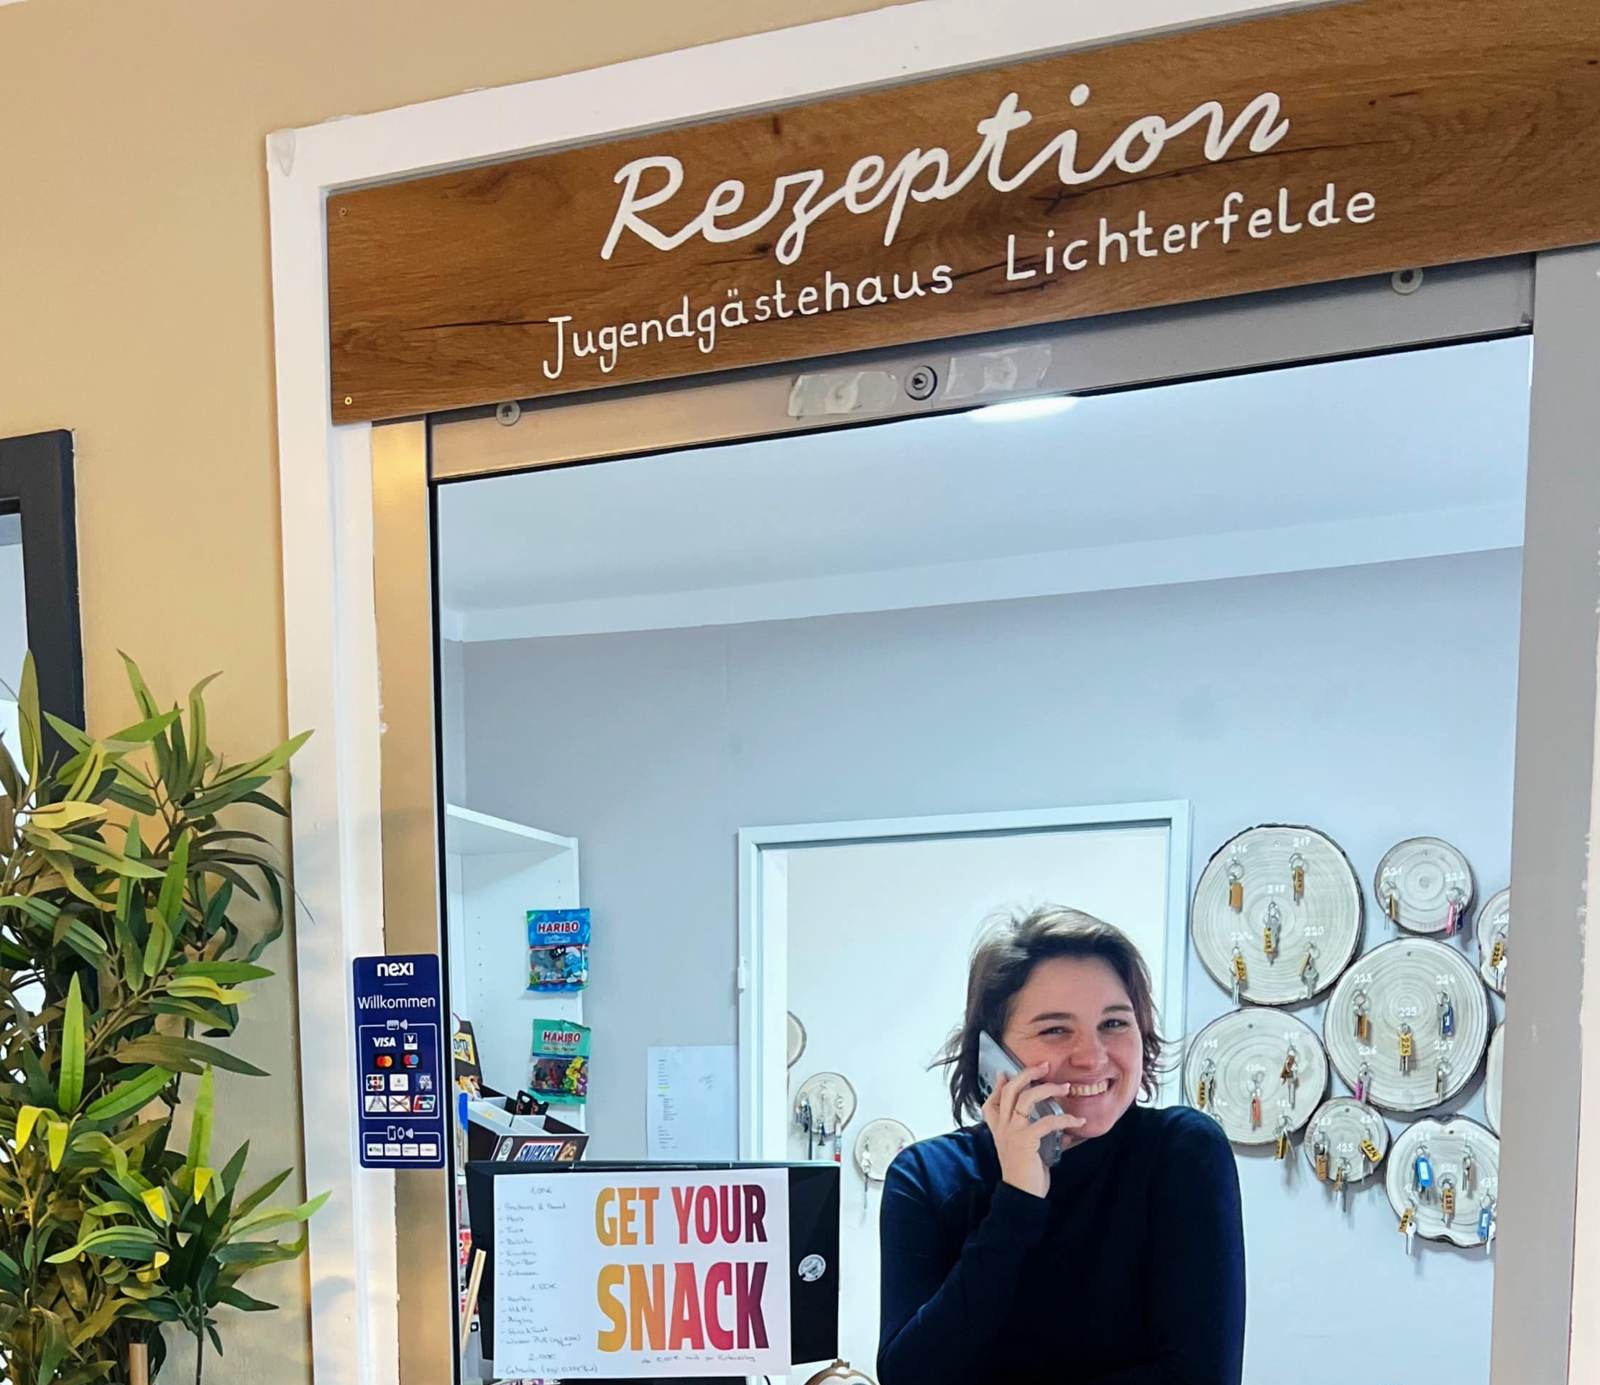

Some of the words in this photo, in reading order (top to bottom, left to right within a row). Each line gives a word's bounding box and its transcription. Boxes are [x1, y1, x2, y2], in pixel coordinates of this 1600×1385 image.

[600, 86, 1290, 266] Rezeption
[543, 262, 954, 379] Jugendgästehaus
[1006, 182, 1376, 282] Lichterfelde
[537, 921, 580, 933] HARIBO
[377, 962, 414, 977] nexi
[357, 995, 436, 1010] Willkommen
[372, 1036, 397, 1048] VISA
[543, 1031, 581, 1043] HARIBO
[595, 1187, 660, 1246] GET
[672, 1184, 768, 1245] YOUR
[597, 1261, 769, 1352] SNACK
